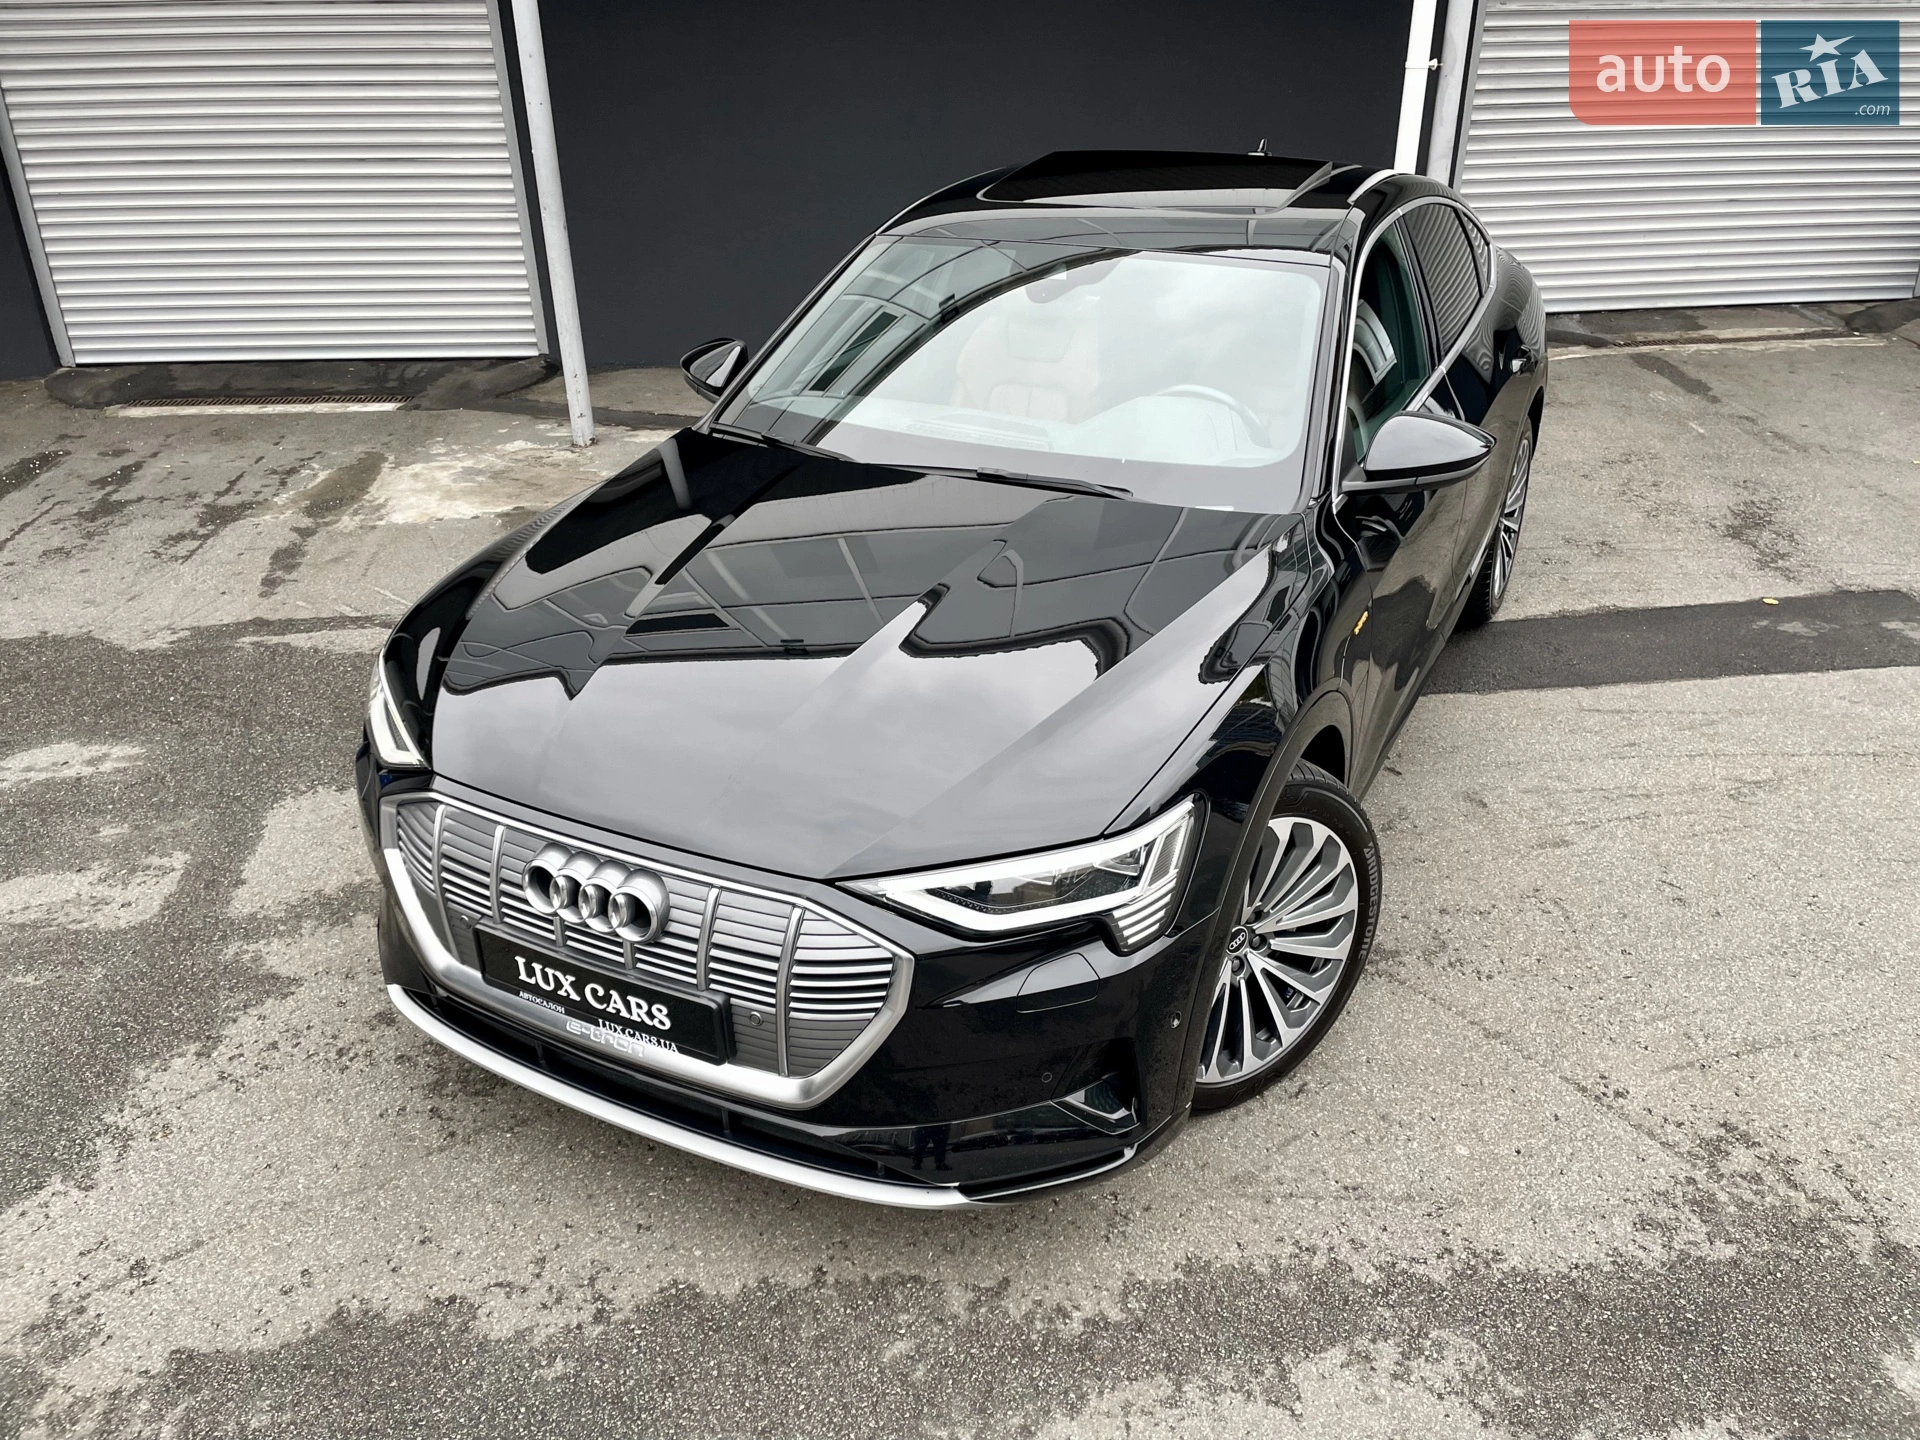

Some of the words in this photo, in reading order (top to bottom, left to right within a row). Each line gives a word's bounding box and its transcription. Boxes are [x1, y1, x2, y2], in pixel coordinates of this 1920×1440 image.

[1358, 841, 1379, 960] BRIDGESTONE
[514, 955, 581, 1002] LUX
[584, 982, 672, 1031] CARS
[518, 990, 566, 1015] АВТОСАЛОН
[565, 1018, 646, 1058] e-tron
